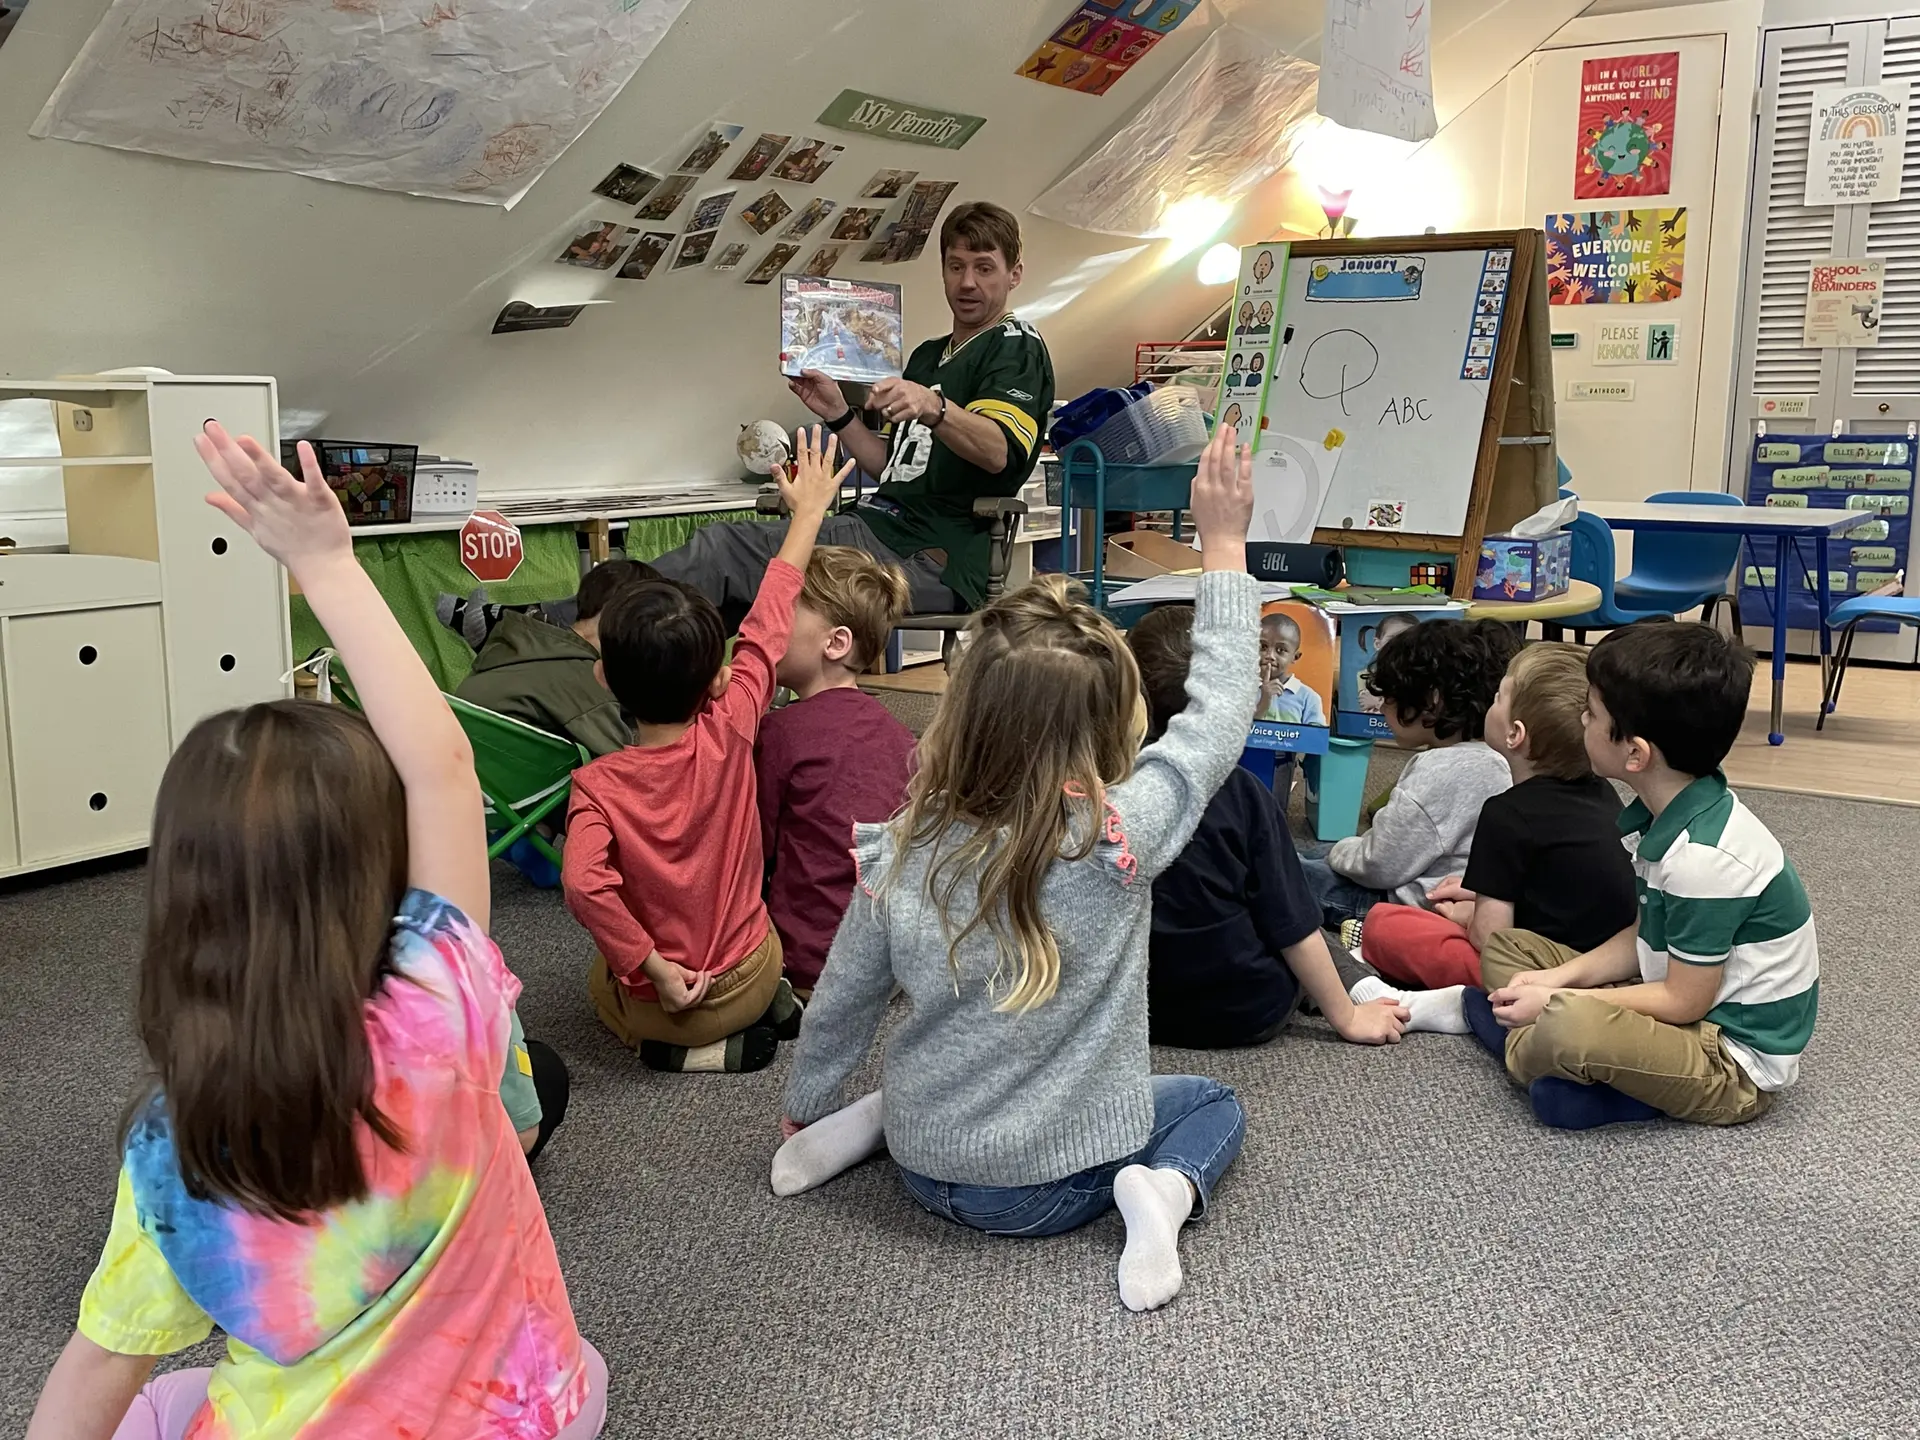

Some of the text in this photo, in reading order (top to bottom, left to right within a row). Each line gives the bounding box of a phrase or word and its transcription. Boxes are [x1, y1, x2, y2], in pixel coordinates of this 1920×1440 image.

[1600, 64, 1661, 79] IN A WORLD
[1584, 78, 1673, 92] WHERE YOU CAN BE
[1584, 87, 1670, 103] ANYTHING BE KIND
[1820, 103, 1901, 118] IN THIS CLASSROOM
[849, 100, 962, 144] My Family
[1571, 239, 1653, 258] EVERYONE
[1340, 258, 1398, 273] January
[1606, 254, 1616, 263] IS
[1572, 260, 1651, 278] WELCOME
[1813, 265, 1868, 277] SCHOOL-
[1597, 280, 1622, 288] HERE
[1811, 281, 1877, 292] REMINDERS
[1601, 327, 1640, 341] PLEASE
[1238, 337, 1243, 347] 1
[1597, 344, 1640, 360] KNOCK
[1225, 388, 1233, 398] 2
[1378, 396, 1433, 426] ABC
[1791, 475, 1820, 483] JONAH
[464, 531, 518, 560] STOP
[1262, 553, 1289, 572] JBL
[1249, 724, 1300, 741] Voice quiet
